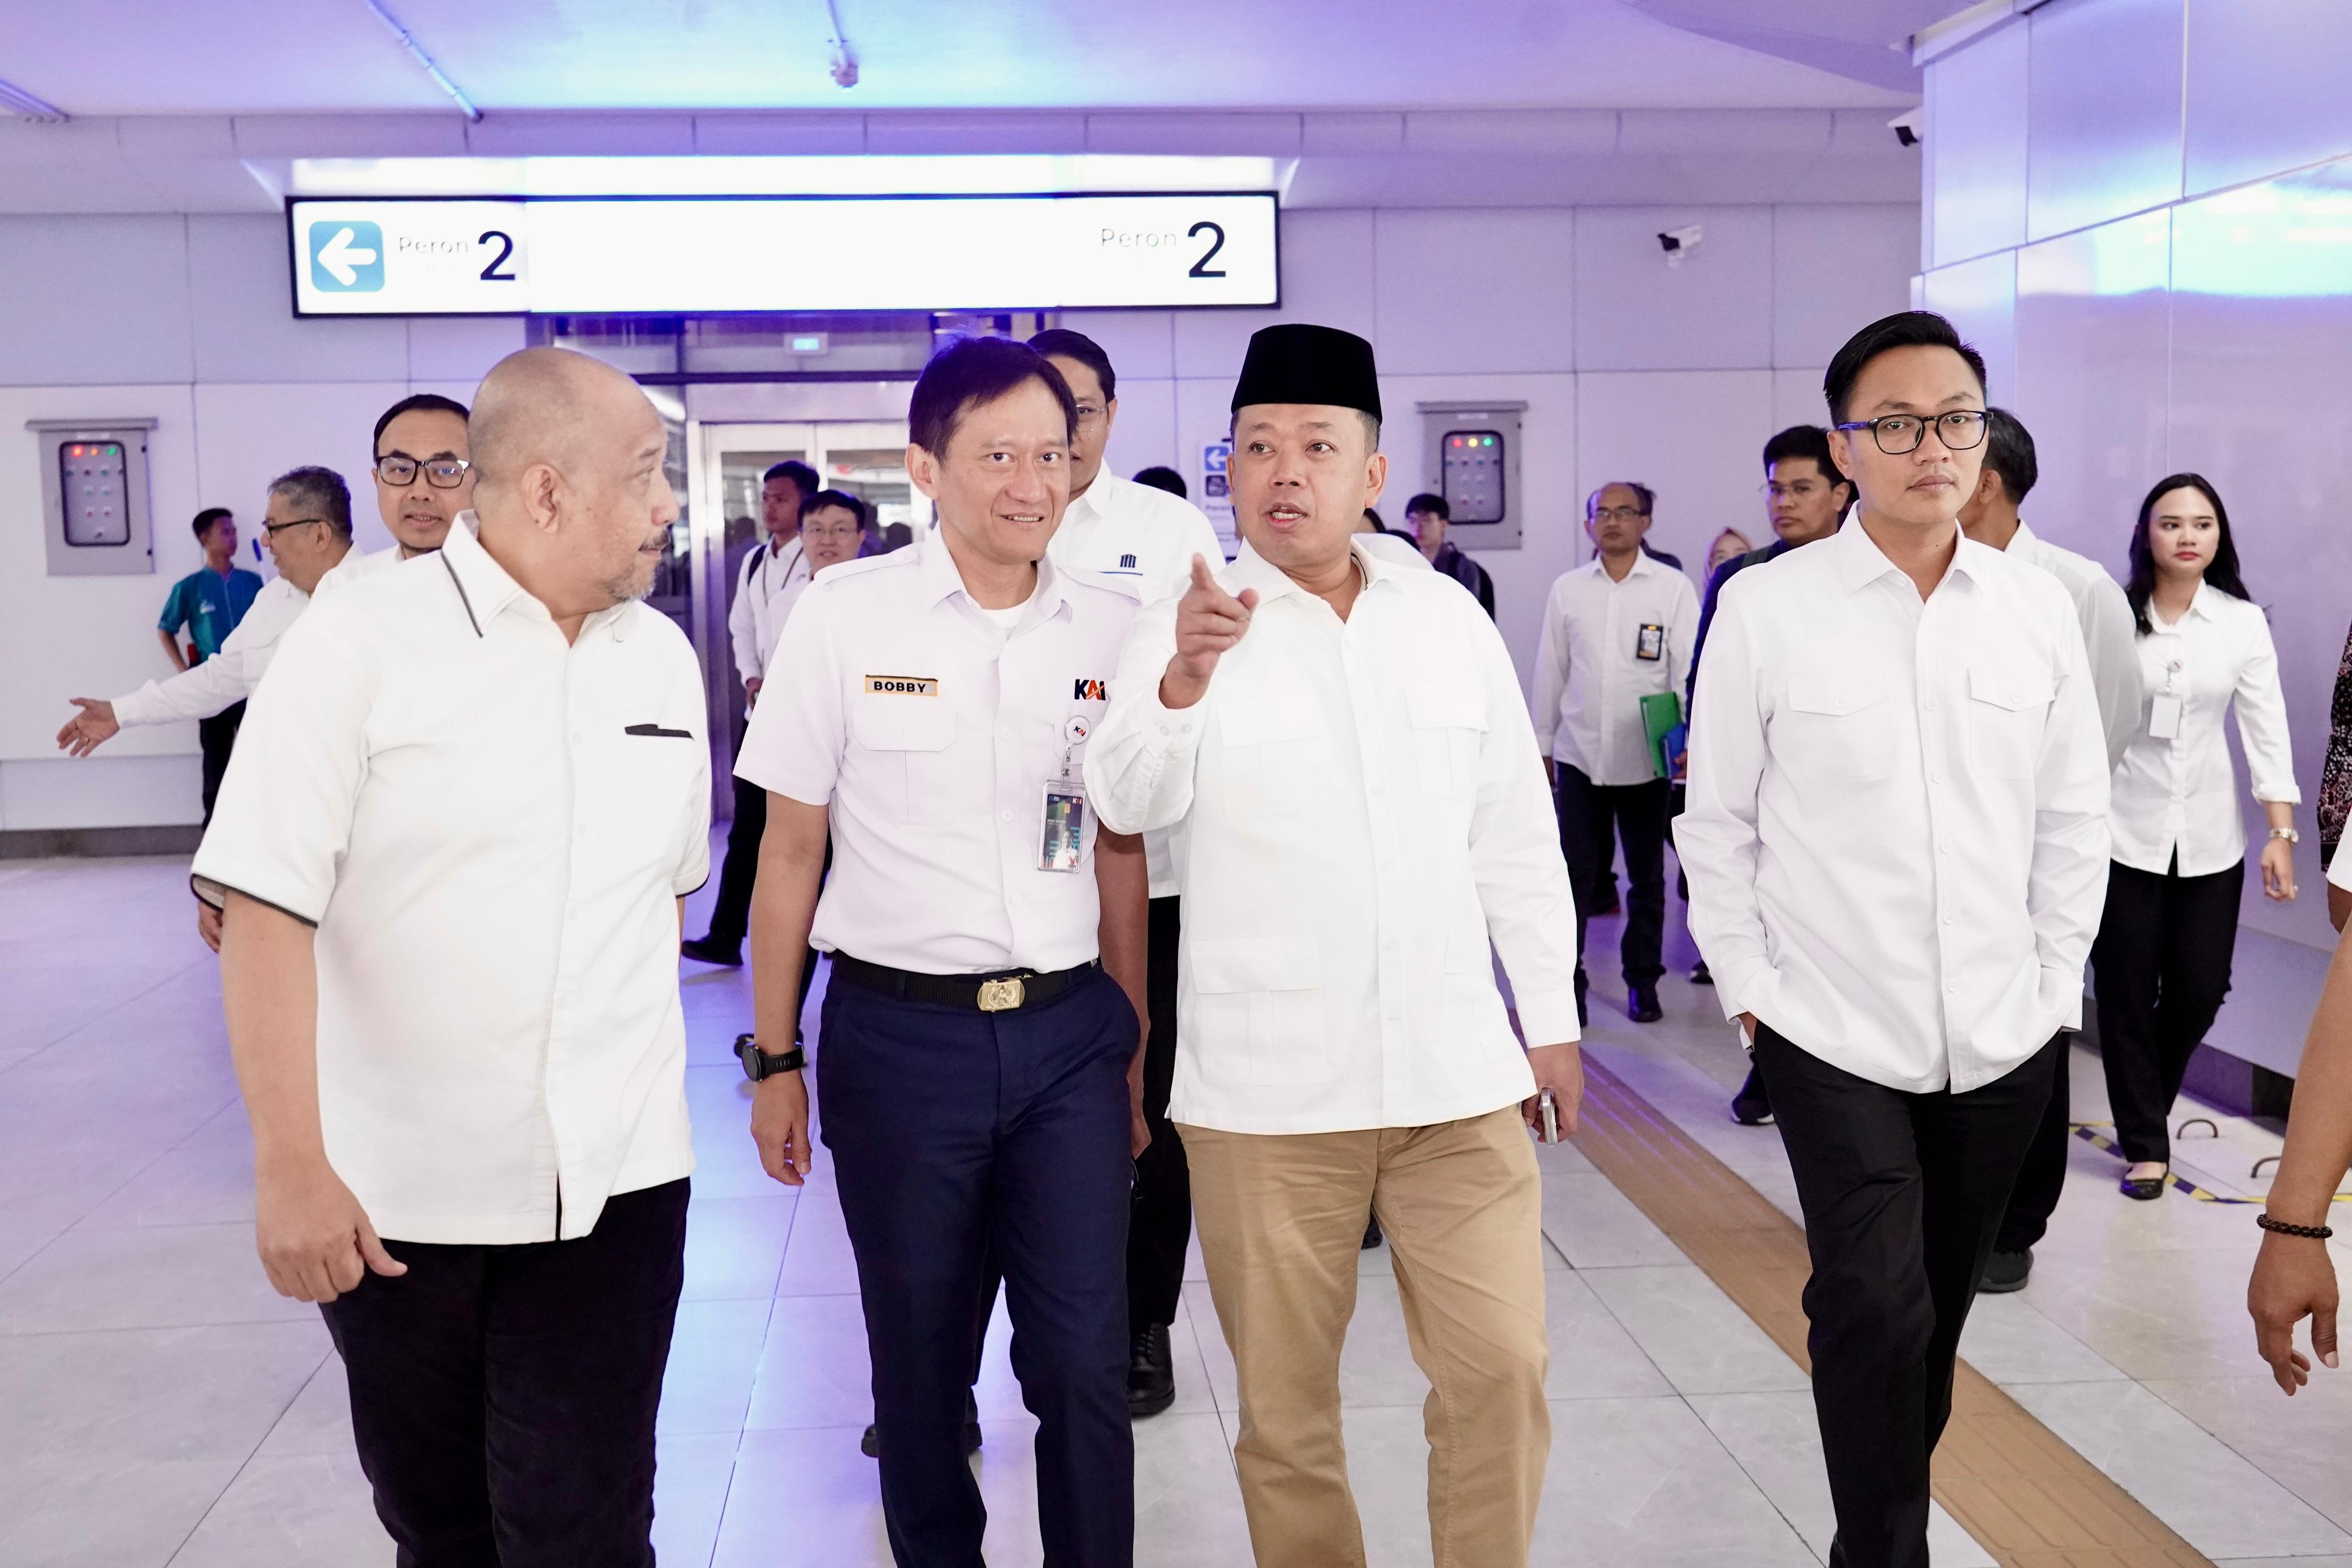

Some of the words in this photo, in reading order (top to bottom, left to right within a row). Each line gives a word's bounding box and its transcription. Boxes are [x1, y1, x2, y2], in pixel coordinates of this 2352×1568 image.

[399, 237, 468, 253] Peron
[478, 231, 516, 280] 2
[1102, 228, 1176, 248] Peron
[1187, 221, 1226, 278] 2
[874, 681, 926, 692] BOBBY
[1074, 679, 1106, 701] KAI
